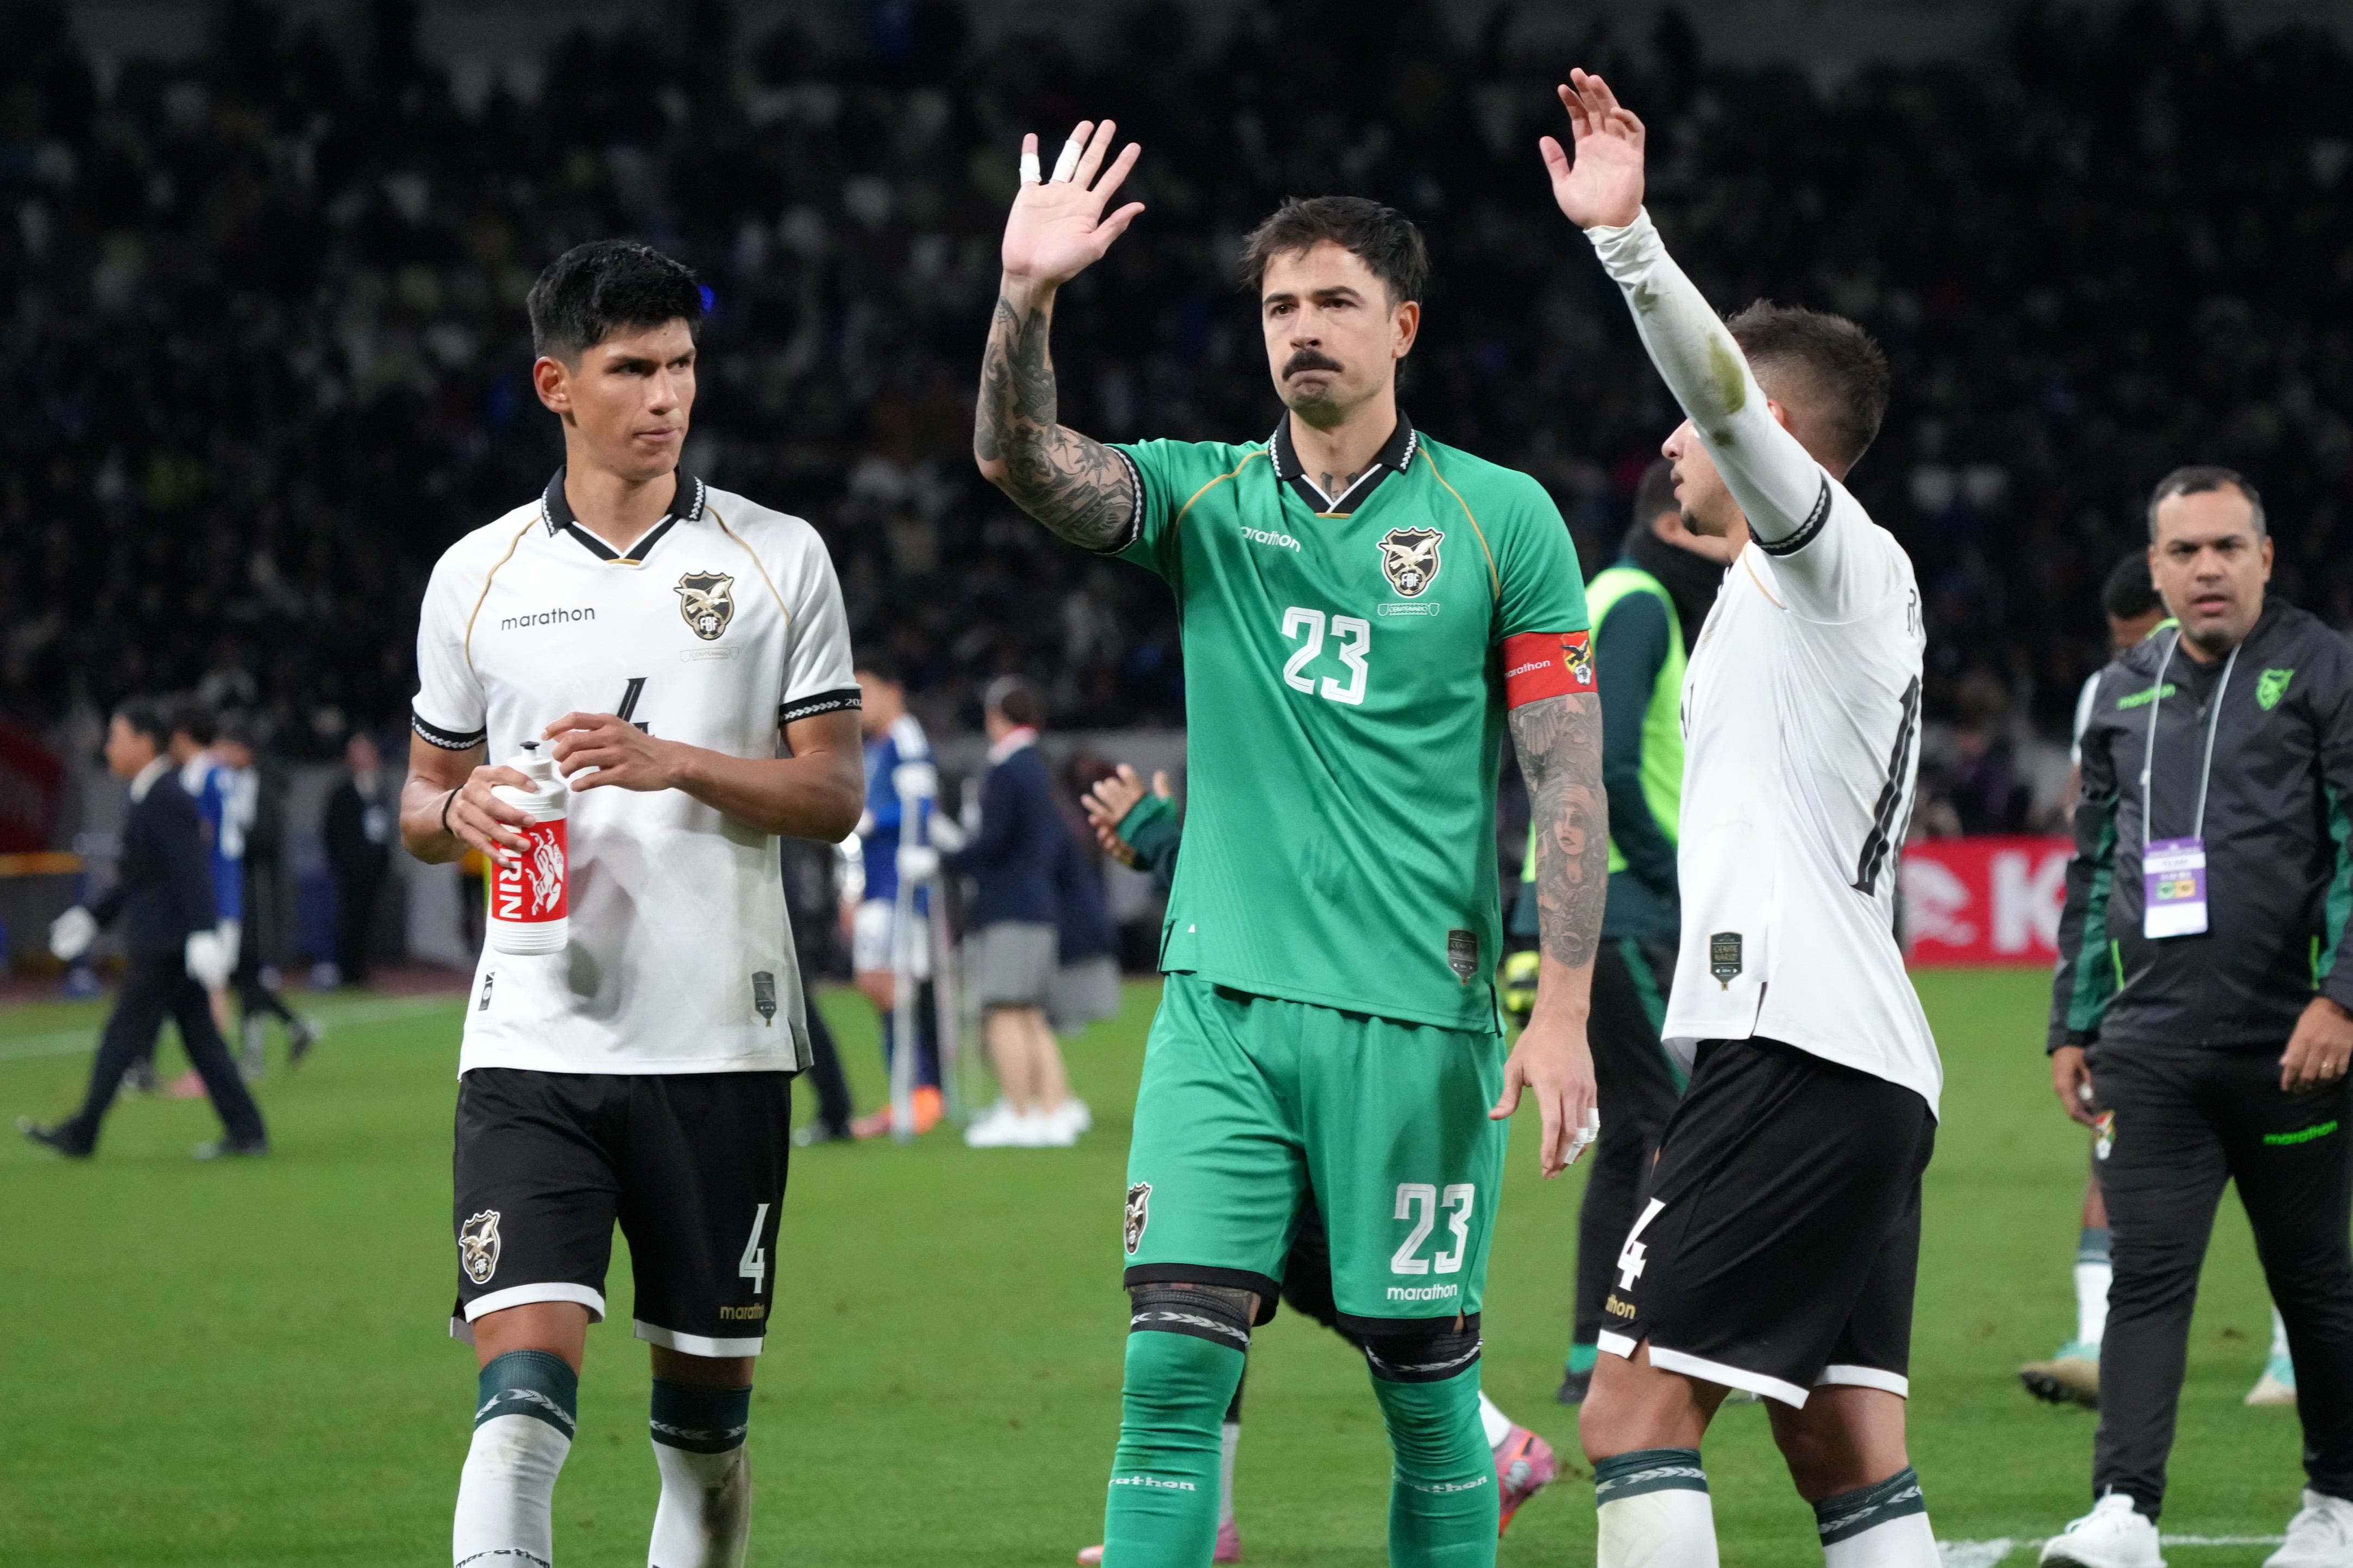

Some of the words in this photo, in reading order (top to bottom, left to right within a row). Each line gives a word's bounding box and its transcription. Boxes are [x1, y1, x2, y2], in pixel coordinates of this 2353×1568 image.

[501, 608, 595, 631] marathon
[700, 616, 718, 632] FBF
[1281, 606, 1370, 706] 23
[2263, 1119, 2338, 1146] marathon
[738, 1203, 771, 1294] 4
[1390, 1182, 1476, 1275] 23
[1617, 1197, 1667, 1292] 4
[1386, 1284, 1458, 1300] marathon
